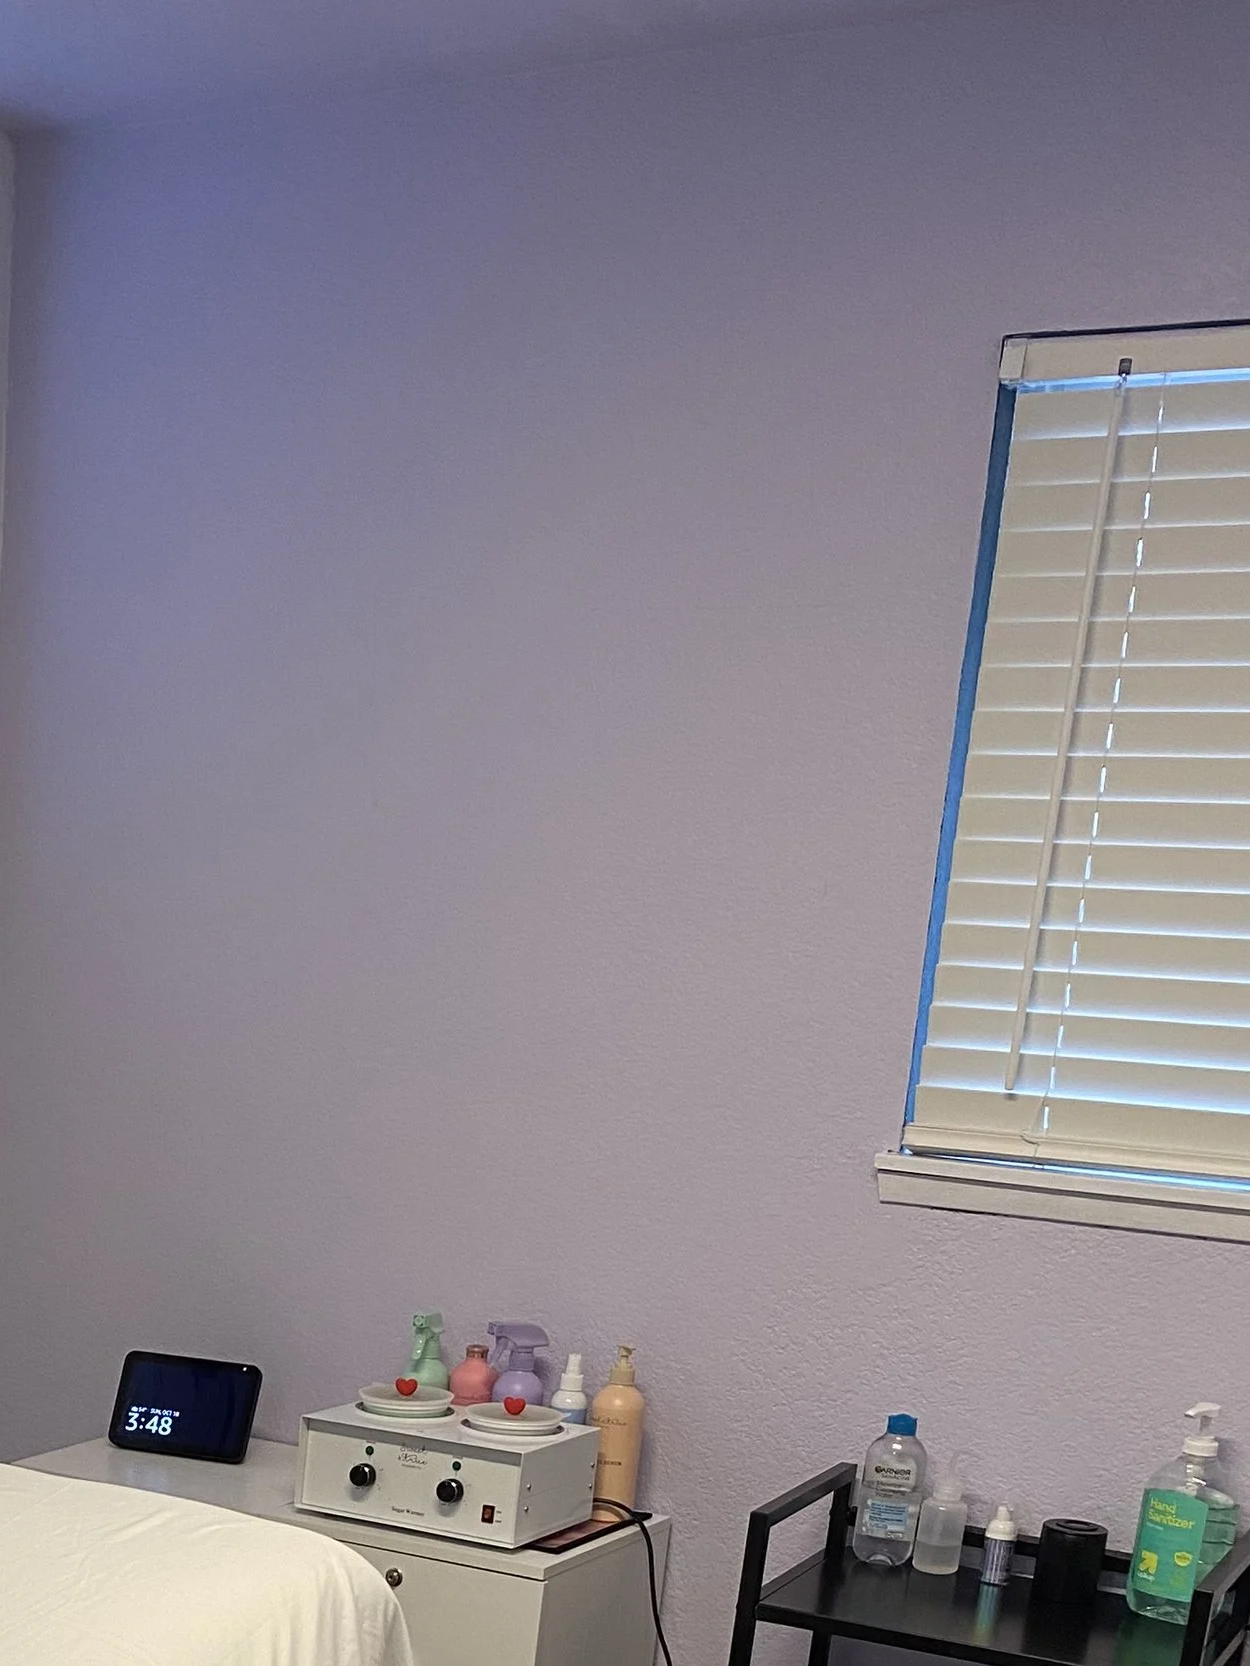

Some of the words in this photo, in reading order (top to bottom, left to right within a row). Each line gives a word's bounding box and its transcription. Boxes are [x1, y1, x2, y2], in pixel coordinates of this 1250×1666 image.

[125, 1412, 172, 1435] 3:48
[875, 1466, 911, 1475] GARNIER
[1150, 1497, 1177, 1514] Hand
[1148, 1511, 1195, 1529] Sanitizer
